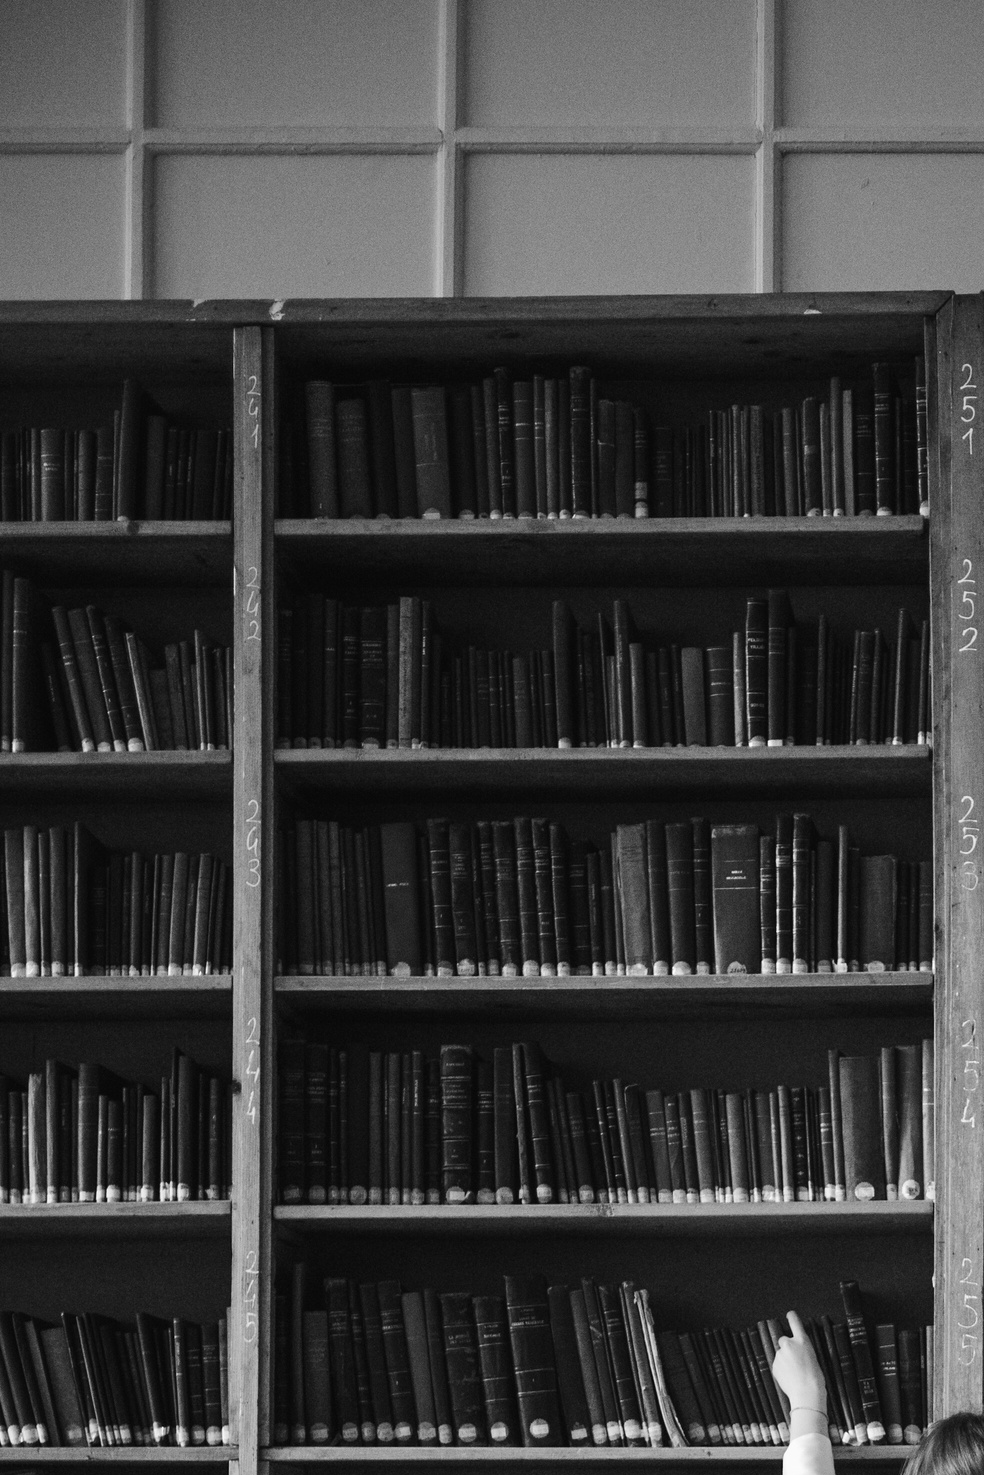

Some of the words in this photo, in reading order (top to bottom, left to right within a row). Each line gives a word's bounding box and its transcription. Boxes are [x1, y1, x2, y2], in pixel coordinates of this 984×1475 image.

[247, 376, 261, 449] 241
[960, 363, 977, 455] 251
[247, 567, 261, 640] 242
[956, 559, 978, 652] 252
[247, 800, 262, 887] 243
[959, 796, 980, 892] 253
[246, 1018, 260, 1125] 244
[960, 1019, 979, 1129] 254
[243, 1251, 259, 1343] 245
[957, 1257, 979, 1366] 255
